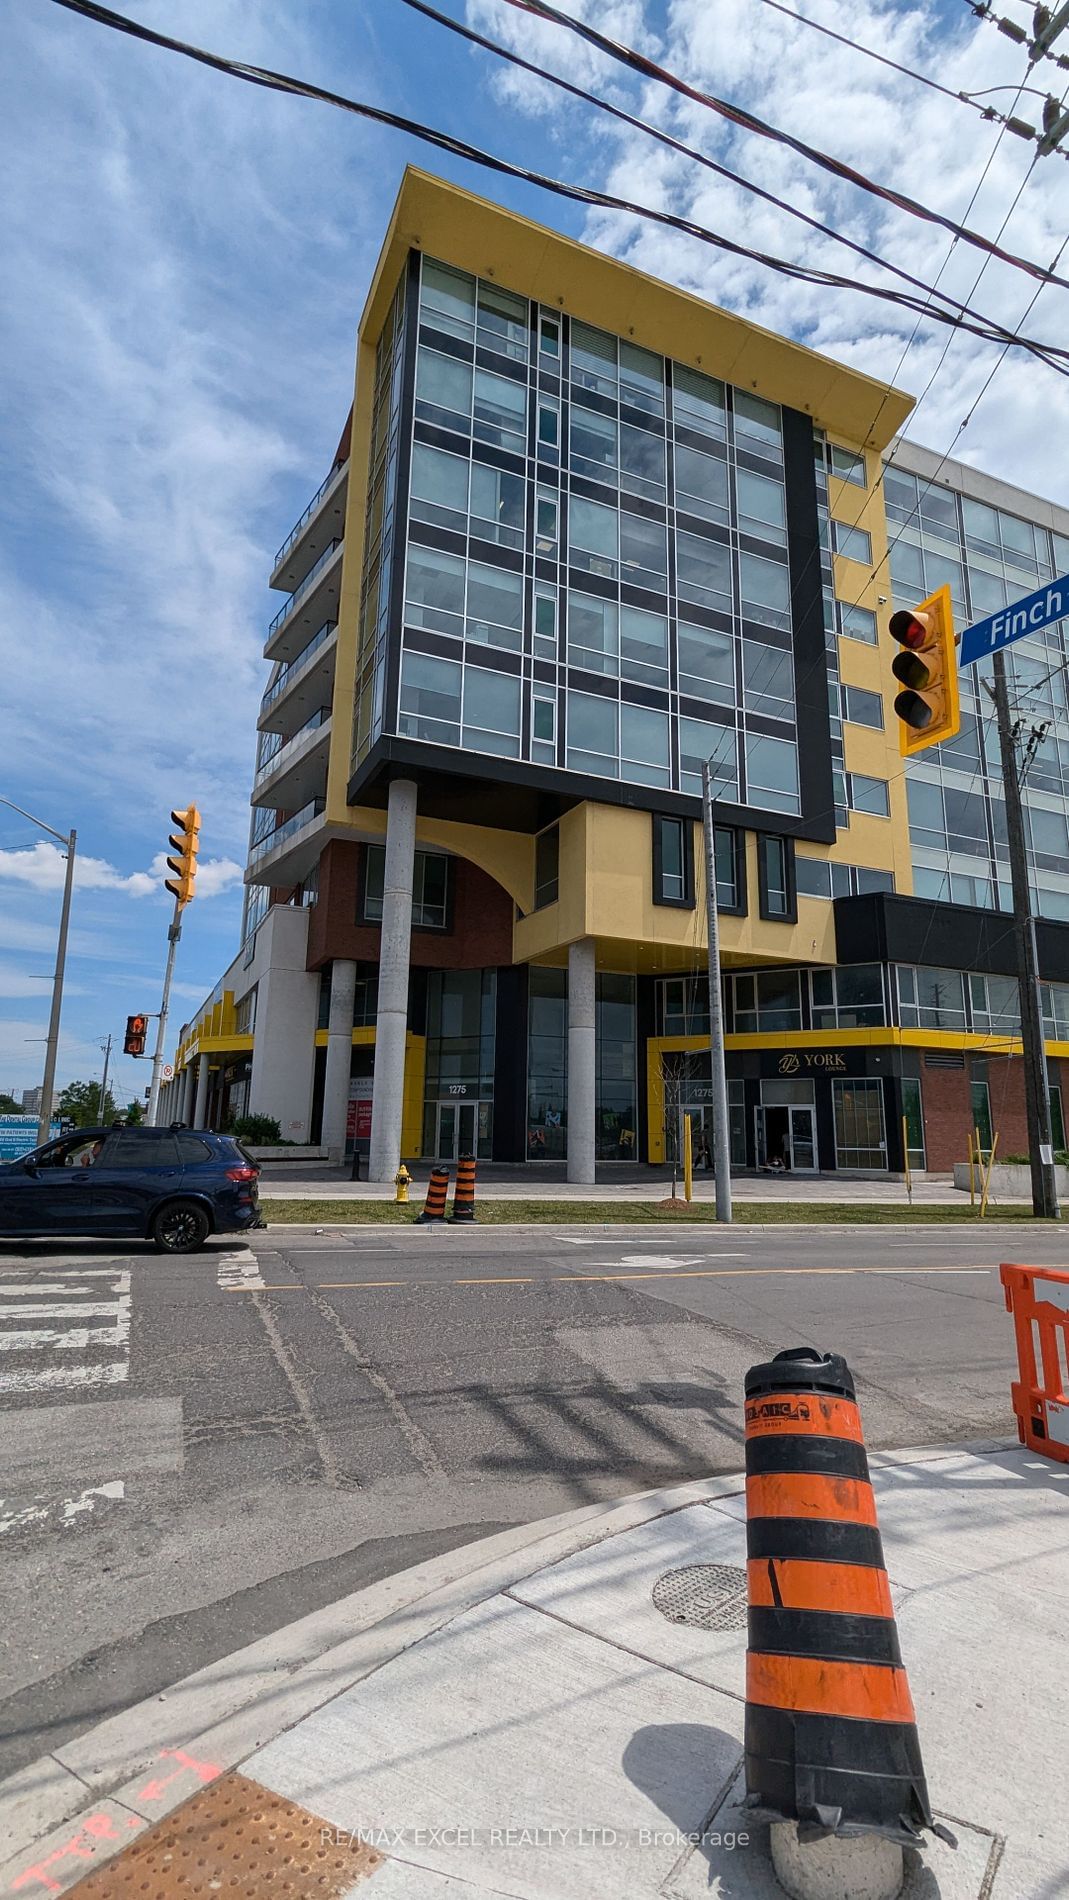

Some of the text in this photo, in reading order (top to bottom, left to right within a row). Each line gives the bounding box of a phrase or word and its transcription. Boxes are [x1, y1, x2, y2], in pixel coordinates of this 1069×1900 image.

[990, 589, 1062, 646] Finch
[804, 1053, 846, 1066] YORK
[448, 1085, 467, 1094] 1275
[693, 1088, 713, 1097] 1275
